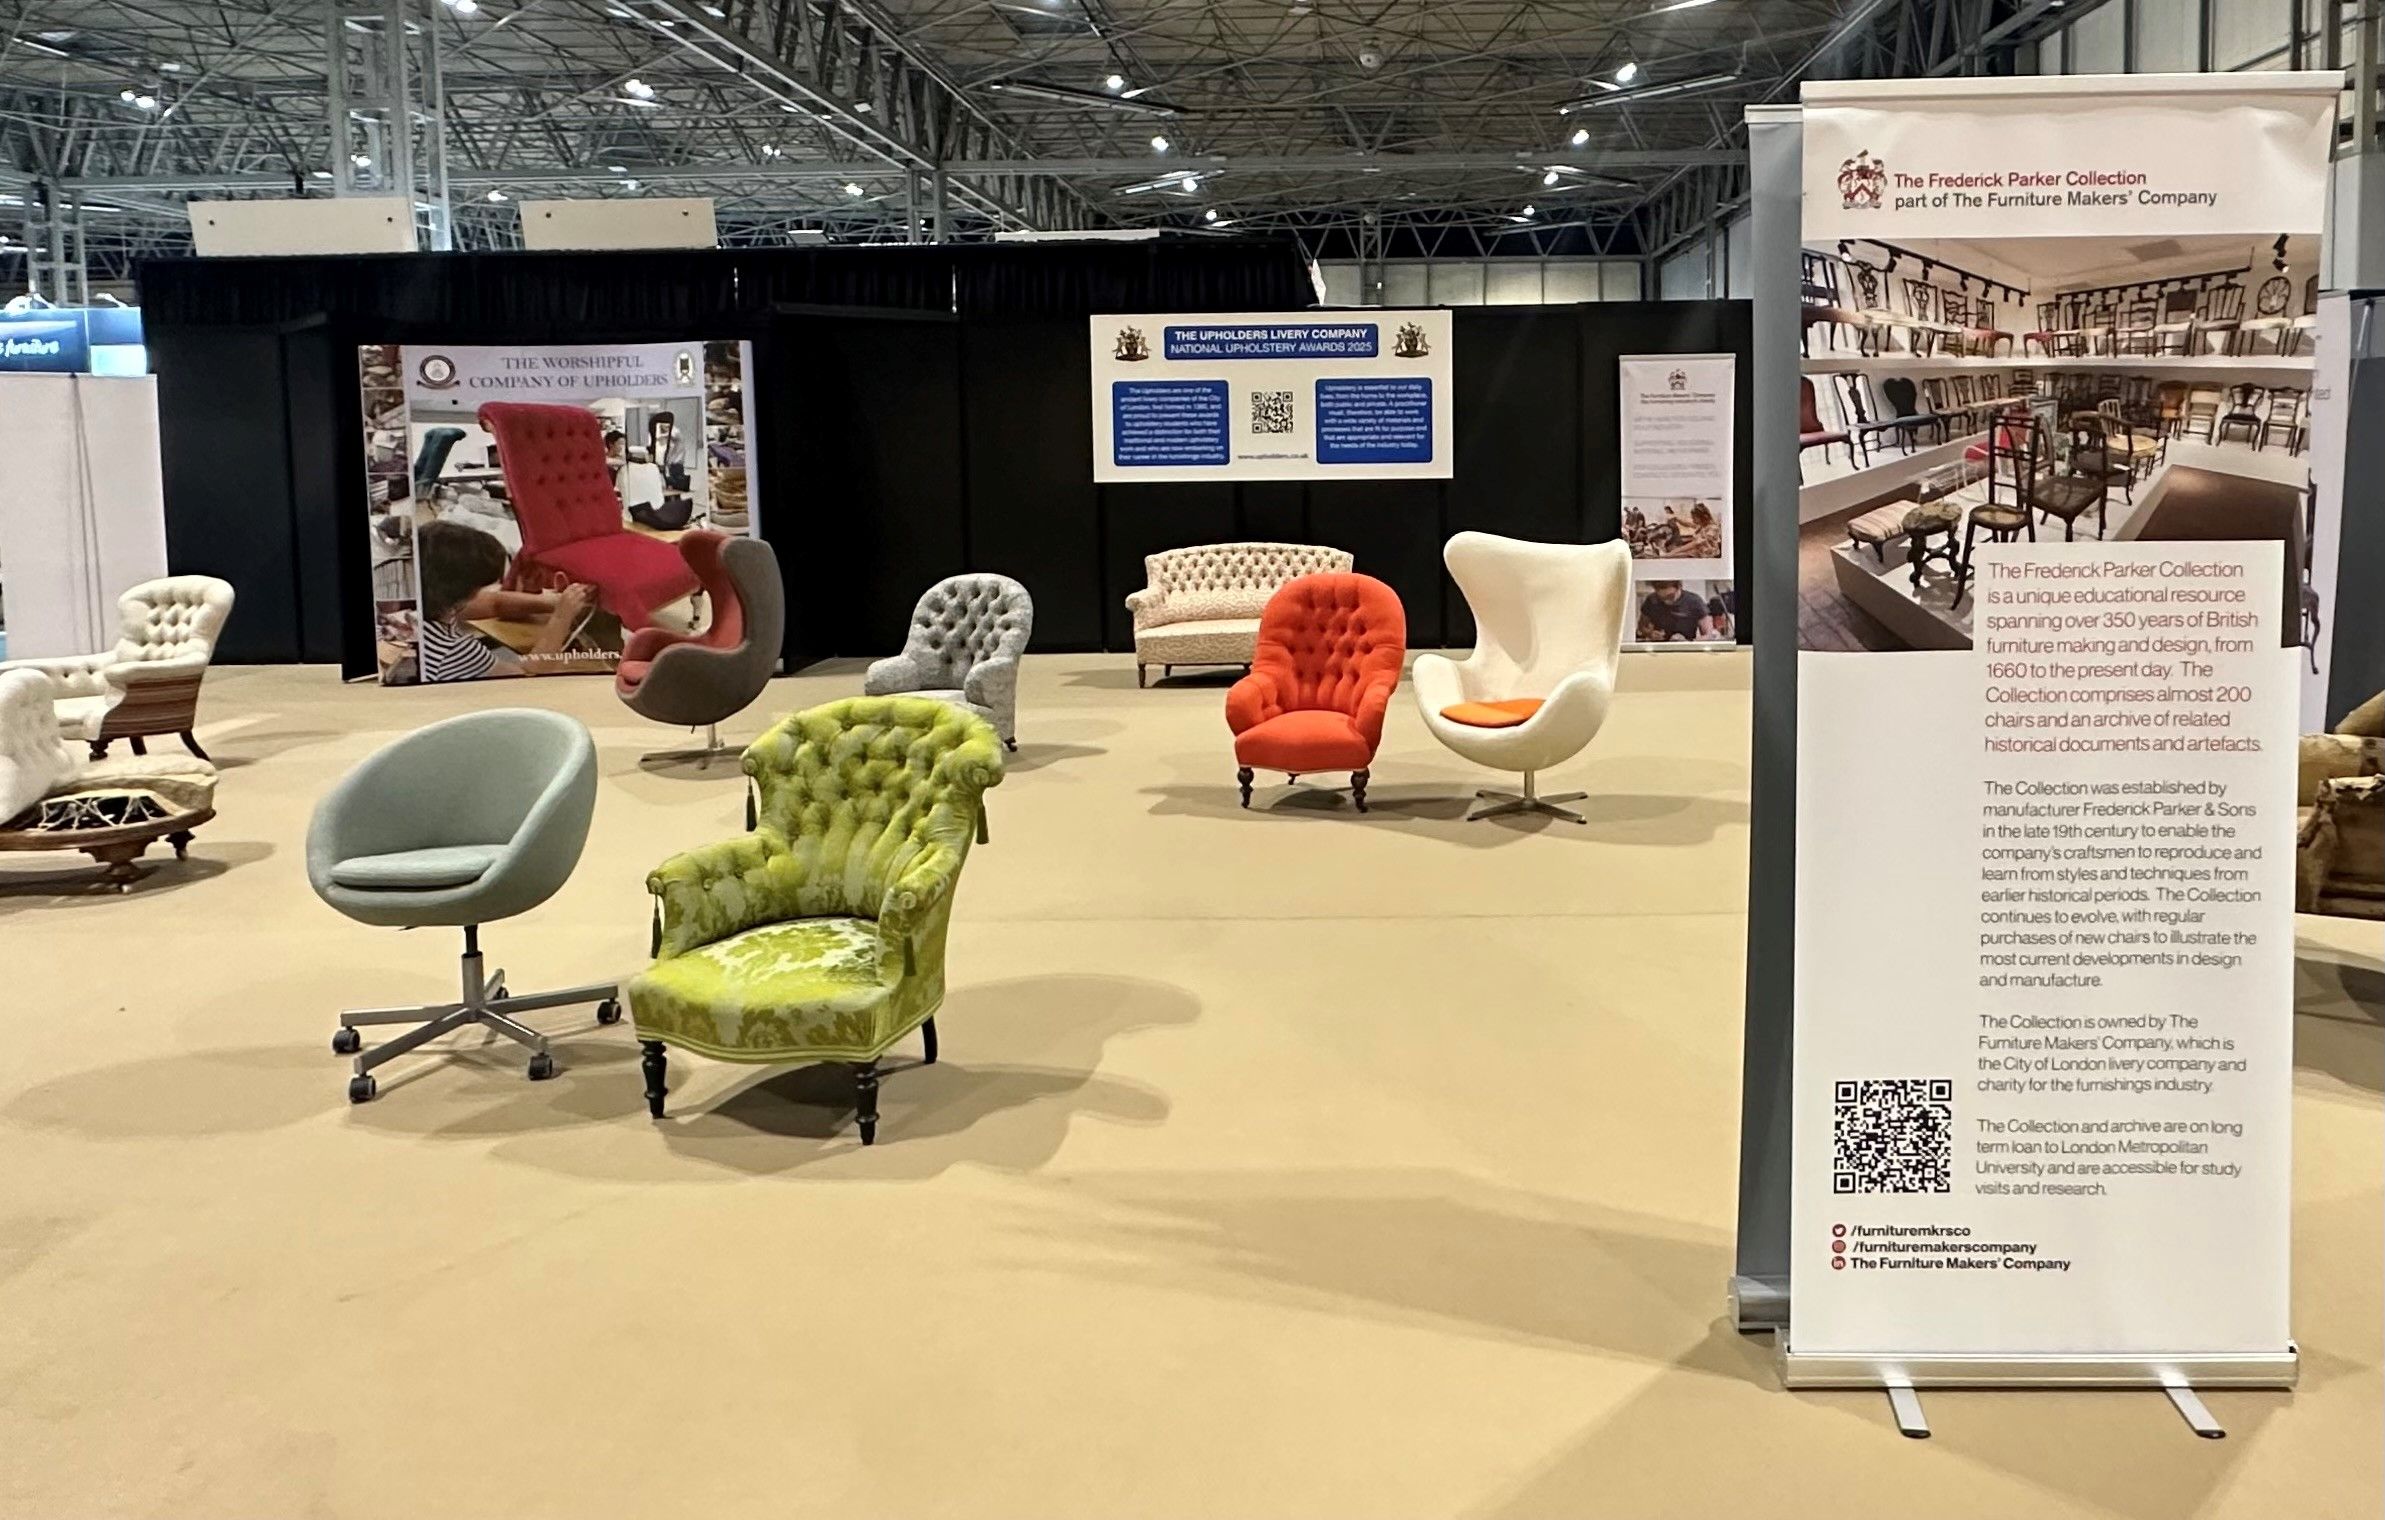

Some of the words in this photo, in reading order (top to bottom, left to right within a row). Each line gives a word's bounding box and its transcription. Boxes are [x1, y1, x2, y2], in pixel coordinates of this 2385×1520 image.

[1894, 174, 1924, 188] The
[1929, 173, 2003, 187] Frederick
[2008, 172, 2061, 186] Parker
[2066, 171, 2146, 186] Collection
[1895, 194, 1927, 211] part
[1932, 193, 1948, 207] of
[1953, 193, 1982, 207] The
[1988, 192, 2062, 207] Furniture
[2068, 190, 2132, 205] Makers'
[2138, 190, 2217, 207] Company
[1175, 331, 1197, 340] THE
[1200, 330, 1268, 340] UPHOLDERS
[1271, 330, 1309, 339] LIVERY
[1312, 329, 1367, 339] COMPANY
[1171, 344, 1224, 354] NATIONAL
[1225, 343, 1296, 353] UPHOLSTERY
[1299, 342, 1345, 352] AWARDS
[1347, 342, 1372, 352] 2025
[503, 357, 539, 369] THE
[542, 355, 644, 369] WORSHIPFUL
[468, 375, 554, 388] COMPANY
[557, 375, 581, 388] OF
[583, 373, 669, 388] UPHOLDERS
[1988, 562, 2021, 579] The
[2024, 562, 2101, 579] Frederick
[2103, 561, 2157, 578] Parker
[2159, 561, 2244, 577] Collection
[1988, 588, 2001, 604] is
[2003, 591, 2013, 604] a
[2016, 588, 2072, 606] unique
[2074, 587, 2168, 603] educational
[2171, 590, 2246, 603] resource
[1987, 613, 2062, 632] spanning
[2065, 616, 2101, 628] over
[2103, 611, 2136, 628] 350
[2138, 615, 2184, 630] years
[2186, 611, 2204, 628] of
[2206, 611, 2258, 628] British
[1987, 637, 2054, 654] furniture
[2057, 637, 2116, 656] making
[2118, 636, 2150, 652] and
[2152, 636, 2212, 656] design,
[2214, 636, 2253, 652] from
[1987, 662, 2027, 678] 1660
[2030, 663, 2046, 678] to
[2049, 662, 2075, 678] the
[2077, 662, 2139, 680] present
[2141, 662, 2173, 680] day.
[2181, 661, 2213, 677] The
[1984, 686, 2068, 703] Collection
[2070, 687, 2155, 705] comprises
[2157, 686, 2214, 702] almost
[2216, 686, 2252, 702] 200
[1985, 712, 2035, 728] chairs
[2037, 712, 2068, 728] and
[2071, 715, 2091, 727] an
[2093, 711, 2151, 727] archive
[2153, 710, 2170, 727] of
[2173, 711, 2231, 727] related
[1985, 737, 2057, 752] historical
[2059, 737, 2150, 752] documents
[2152, 736, 2185, 751] and
[2187, 736, 2263, 751] artefacts.
[1985, 781, 2013, 795] The
[2015, 781, 2088, 795] Collection
[2090, 784, 2119, 795] was
[2122, 780, 2206, 794] established
[2208, 781, 2227, 798] by
[1983, 802, 2081, 817] manufacturer
[2083, 801, 2151, 816] Frederick
[2152, 801, 2202, 816] Parker
[2204, 802, 2216, 816] &
[2217, 802, 2256, 817] Sons
[1983, 824, 1995, 838] in
[1998, 825, 2022, 838] the
[2024, 824, 2050, 838] late
[2052, 824, 2082, 838] 19th
[2084, 824, 2139, 839] century
[2141, 824, 2156, 837] to
[2158, 823, 2209, 838] enable
[2211, 824, 2236, 838] the
[2063, 845, 2135, 860] craftsmen
[2138, 845, 2152, 858] to
[2154, 845, 2232, 861] reproduce
[2234, 845, 2262, 860] and
[1982, 867, 2018, 881] learn
[2021, 867, 2054, 881] from
[2056, 867, 2098, 884] styles
[2100, 866, 2128, 881] and
[2129, 866, 2211, 882] techniques
[2214, 866, 2248, 881] from
[1981, 888, 2026, 902] earlier
[2028, 887, 2092, 902] historical
[2094, 887, 2150, 904] periods.
[2156, 887, 2186, 901] The
[2187, 887, 2261, 902] Collection
[1981, 931, 2057, 947] purchases
[2058, 930, 2073, 945] of
[2075, 934, 2106, 945] new
[2107, 930, 2151, 944] chairs
[2153, 931, 2168, 944] to
[2170, 930, 2232, 945] illustrate
[2233, 932, 2257, 945] the
[1979, 973, 2007, 987] and
[2010, 973, 2103, 987] manufacture.
[1980, 1014, 2008, 1028] The
[2010, 1015, 2082, 1029] Collection
[2084, 1015, 2096, 1029] is
[2097, 1014, 2147, 1029] owned
[2148, 1014, 2167, 1031] by
[2170, 1014, 2198, 1029] The
[1979, 1035, 2042, 1050] Furniture
[2102, 1035, 2174, 1052] Company,
[2176, 1036, 2220, 1050] which
[2223, 1037, 2235, 1050] is
[1978, 1057, 2002, 1070] the
[2003, 1056, 2033, 1073] City
[2034, 1056, 2049, 1071] of
[2051, 1057, 2106, 1071] London
[2108, 1057, 2145, 1072] livery
[2146, 1059, 2216, 1073] company
[2218, 1059, 2247, 1072] and
[1977, 1078, 2027, 1094] charity
[2028, 1077, 2048, 1092] for
[2050, 1078, 2074, 1092] the
[2076, 1078, 2152, 1094] furnishings
[2154, 1077, 2213, 1094] industry.
[1977, 1119, 2005, 1133] The
[2007, 1119, 2079, 1133] Collection
[2080, 1120, 2109, 1133] and
[2110, 1120, 2161, 1133] archive
[2163, 1122, 2187, 1133] are
[2189, 1122, 2209, 1133] on
[2211, 1120, 2243, 1137] long
[1976, 1160, 2046, 1177] University
[2047, 1161, 2075, 1175] and
[2077, 1164, 2101, 1175] are
[2102, 1160, 2177, 1174] accessible
[2179, 1161, 2200, 1174] for
[2201, 1161, 2242, 1178] study
[1851, 1225, 1971, 1236] /furnituremkrsco
[1853, 1241, 2037, 1255] /furnituremakerscompany
[1850, 1258, 1877, 1269] The
[1880, 1257, 1943, 1268] Furniture
[1946, 1257, 2001, 1269] Makers'
[2003, 1258, 2071, 1271] Company
